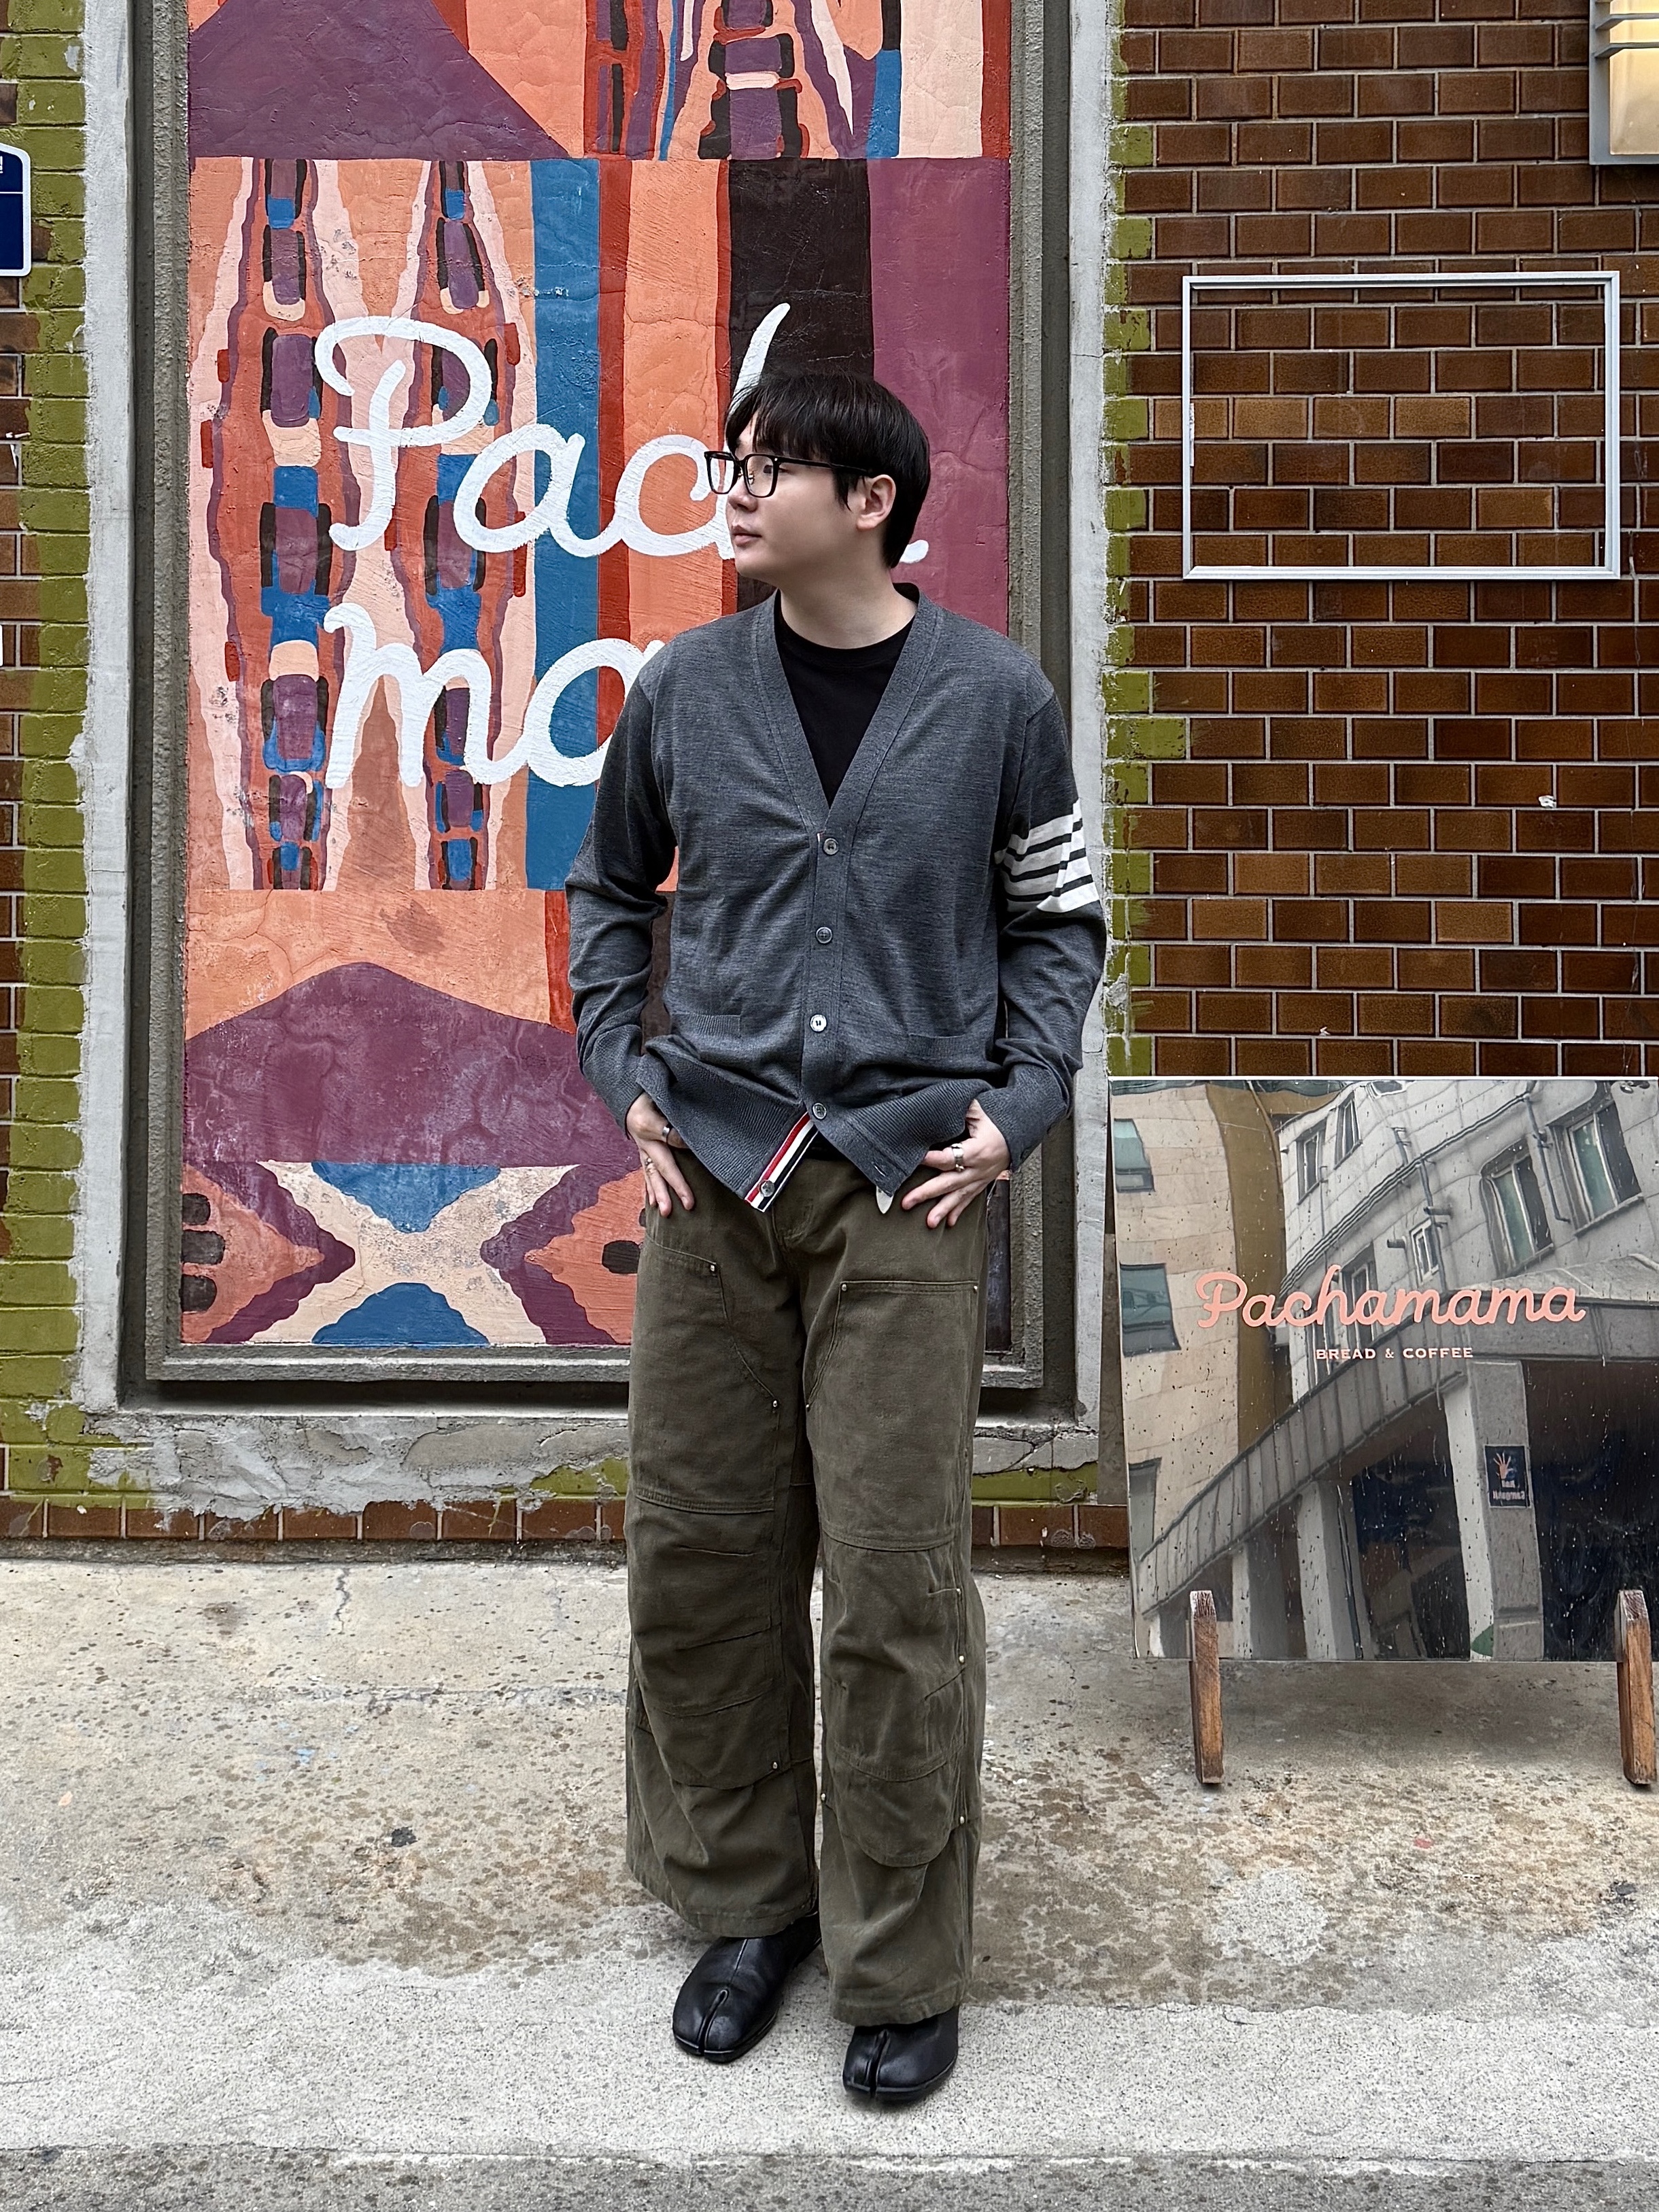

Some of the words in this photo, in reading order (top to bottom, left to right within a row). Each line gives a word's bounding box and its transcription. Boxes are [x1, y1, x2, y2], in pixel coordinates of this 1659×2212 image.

[1195, 1263, 1586, 1328] Pachamama
[1316, 1348, 1377, 1359] BREAD
[1384, 1348, 1395, 1359] &
[1403, 1347, 1473, 1359] COFFEE
